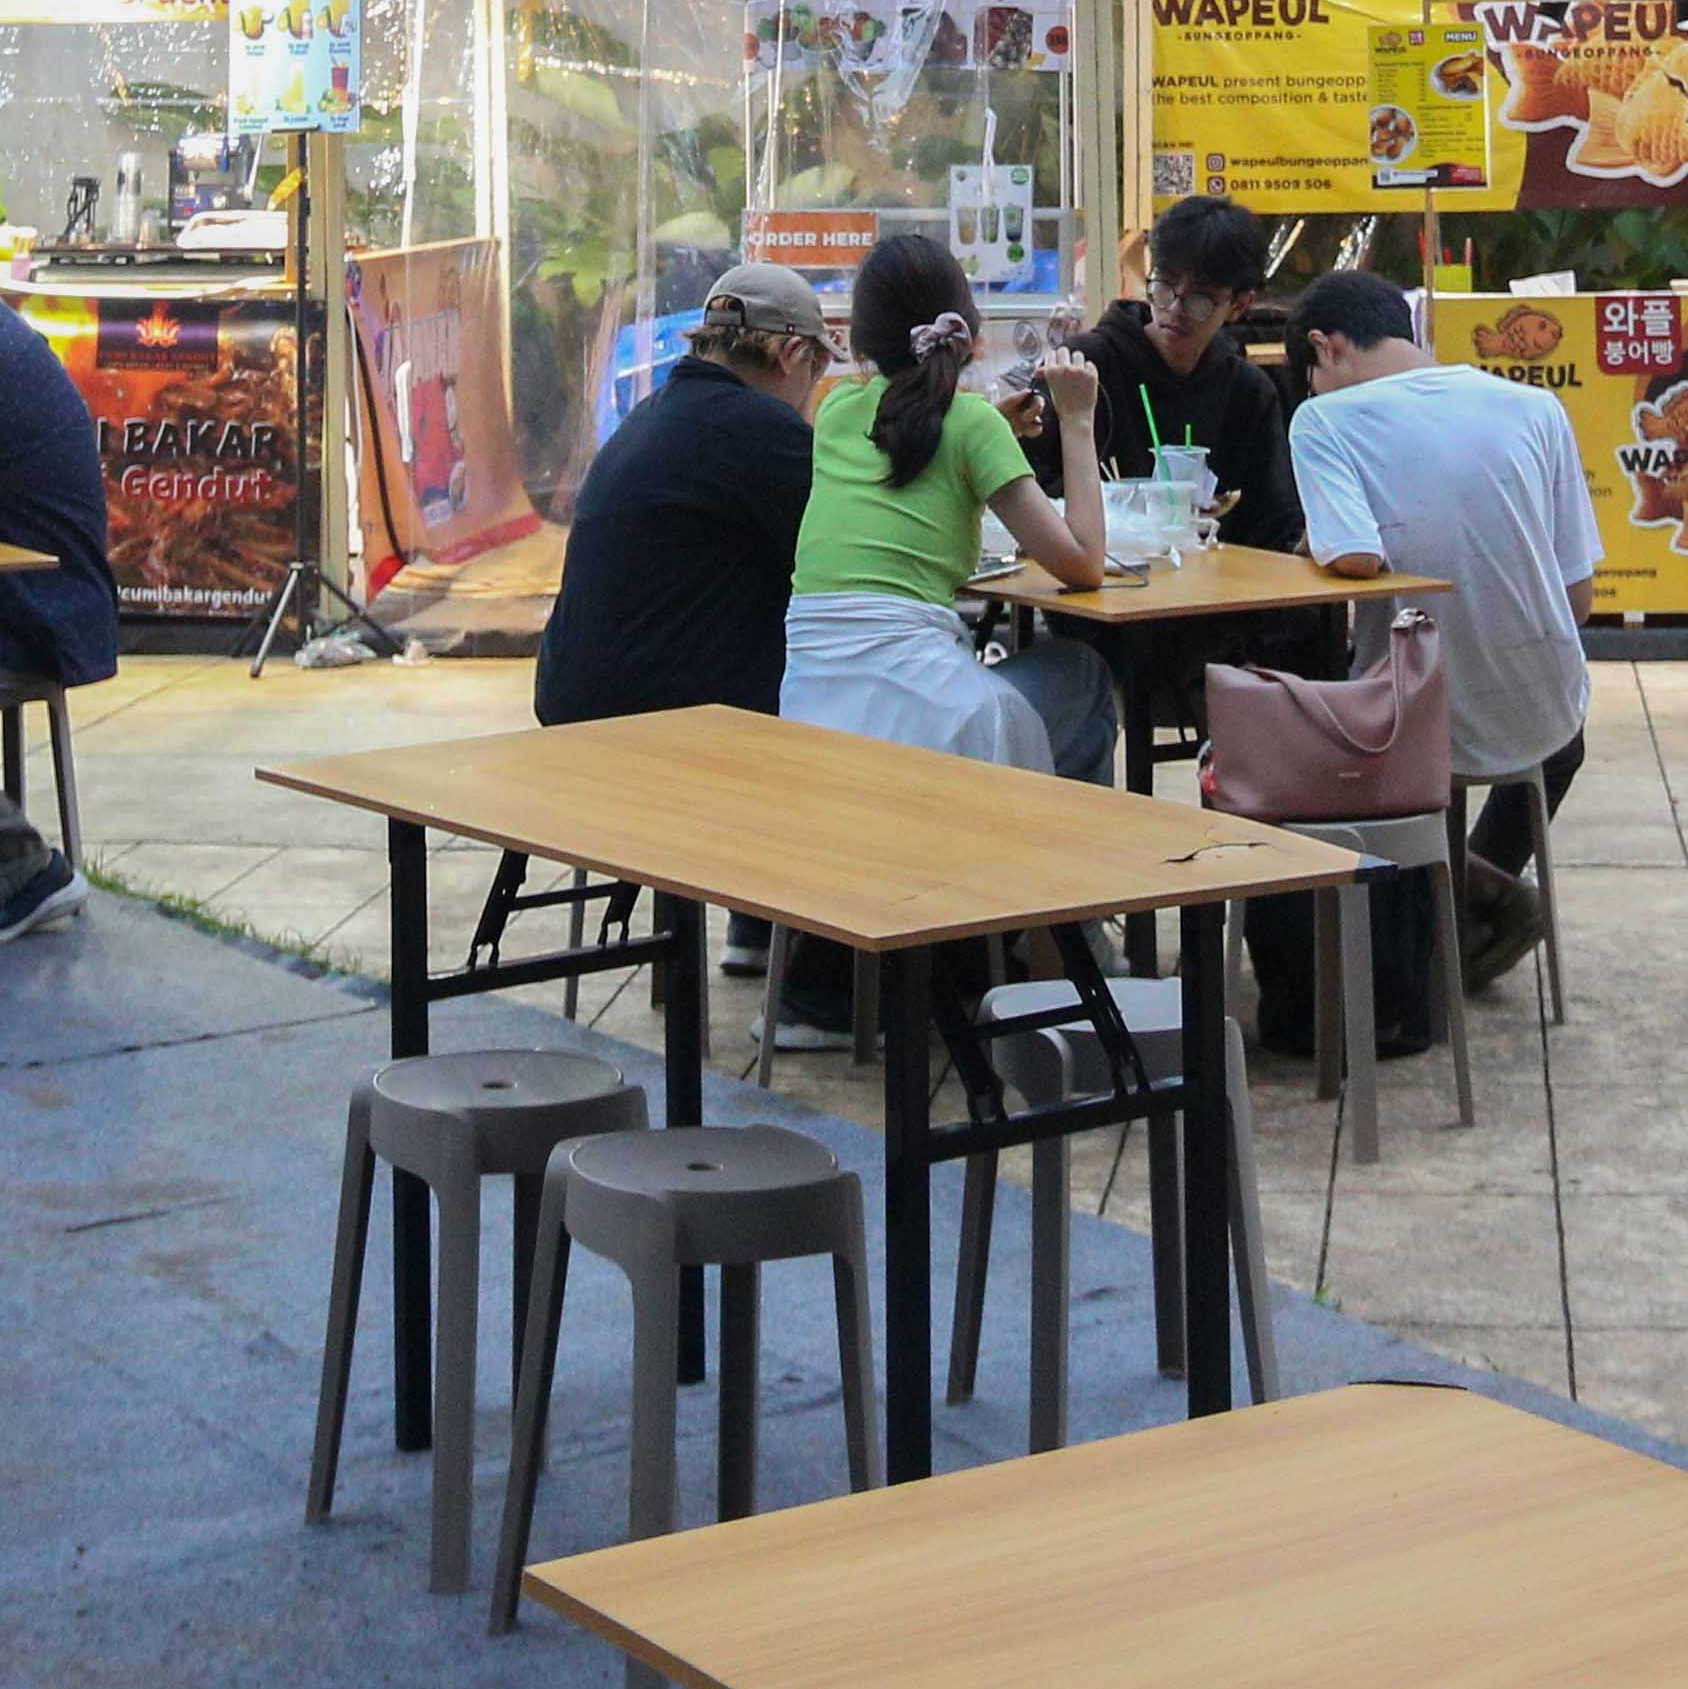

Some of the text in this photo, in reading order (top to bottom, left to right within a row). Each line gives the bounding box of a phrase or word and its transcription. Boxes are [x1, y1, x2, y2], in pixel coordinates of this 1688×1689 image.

[1446, 31, 1477, 42] MENU
[1152, 76, 1218, 88] WAPEUL
[1223, 77, 1281, 89] present
[1179, 92, 1212, 104] best
[1217, 91, 1313, 106] composition
[1318, 92, 1329, 104] &
[1230, 179, 1261, 191] 0811
[1304, 178, 1332, 191] 506
[748, 231, 873, 247] ORDER HERE
[1603, 299, 1675, 337] 와플
[1603, 340, 1675, 366] 붕어빵
[123, 417, 277, 458] BAKAR
[121, 464, 274, 502] Gendut
